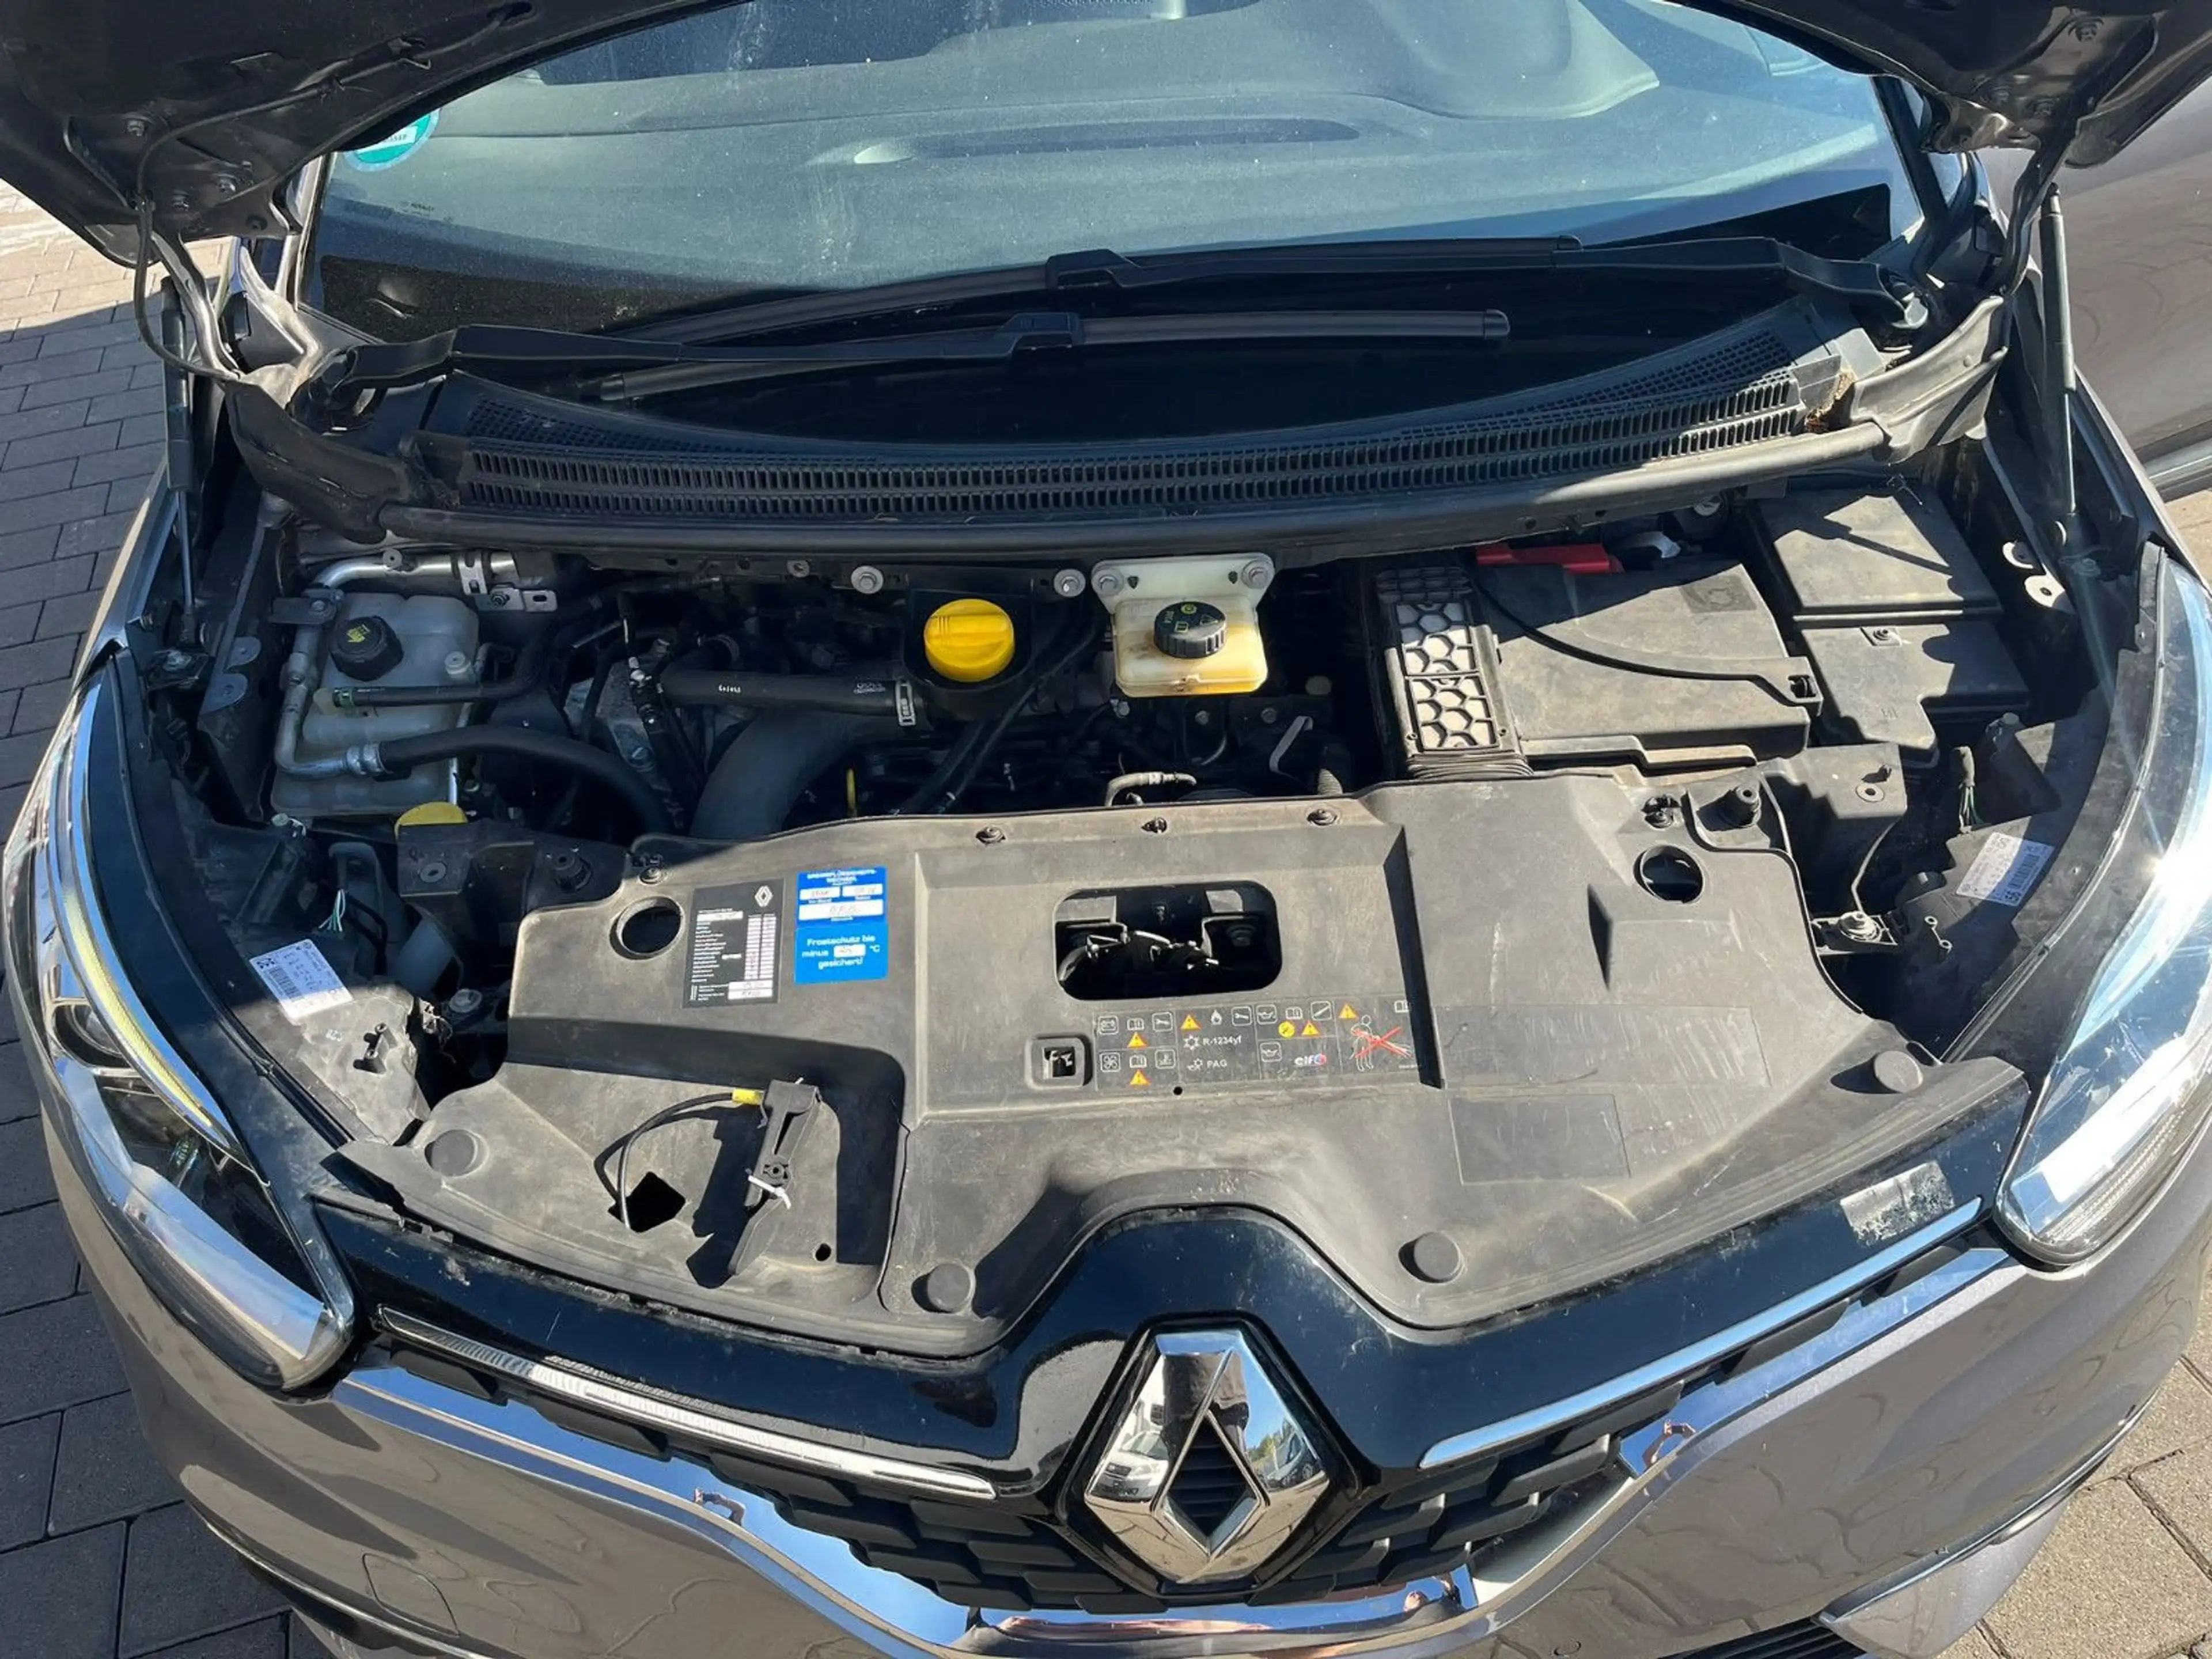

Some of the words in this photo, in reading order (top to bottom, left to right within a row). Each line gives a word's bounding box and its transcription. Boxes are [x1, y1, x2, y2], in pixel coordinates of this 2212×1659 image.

[862, 934, 876, 942] bis
[801, 949, 829, 957] minus
[1203, 1035, 1242, 1046] R-1234yf
[1207, 1059, 1228, 1068] PAG
